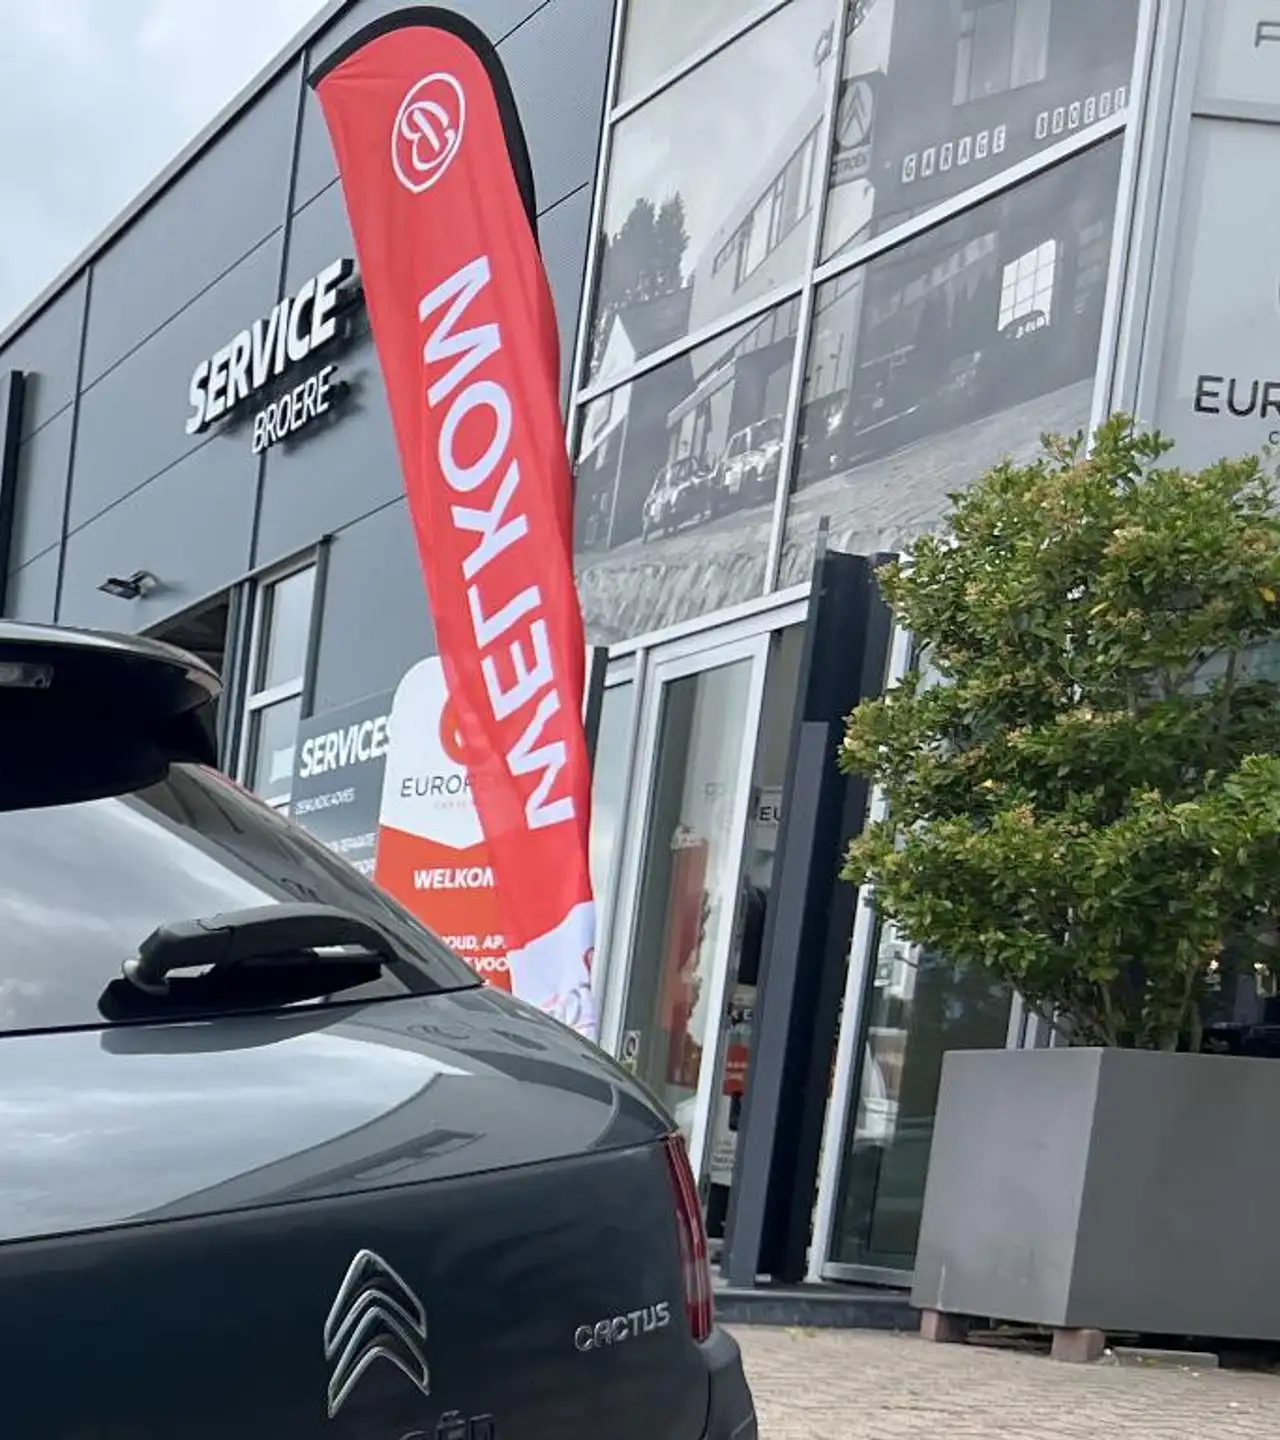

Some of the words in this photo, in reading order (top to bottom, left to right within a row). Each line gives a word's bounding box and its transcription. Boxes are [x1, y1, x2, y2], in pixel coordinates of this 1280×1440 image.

[901, 124, 1007, 184] GARAGE
[185, 258, 343, 435] SERVICE
[252, 365, 333, 454] BROERE
[574, 1300, 671, 1352] CACTUS
